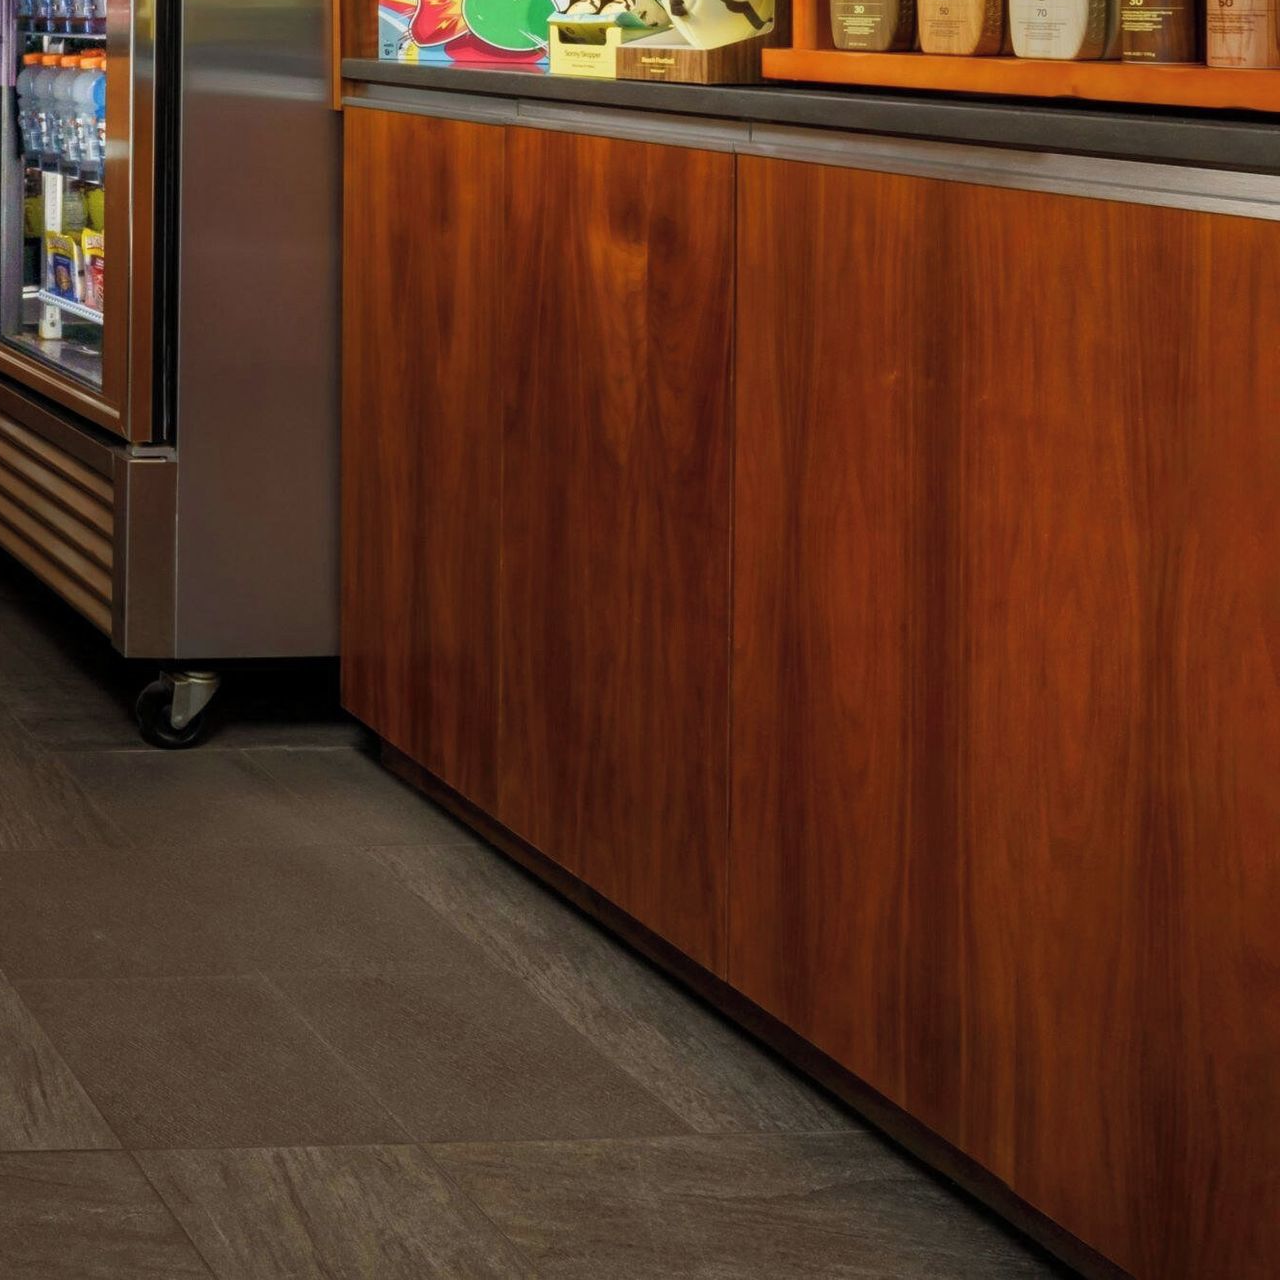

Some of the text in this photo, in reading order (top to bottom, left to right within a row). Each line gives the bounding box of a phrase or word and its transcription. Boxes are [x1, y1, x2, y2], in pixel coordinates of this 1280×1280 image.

[853, 5, 865, 14] 30
[939, 7, 950, 16] 50
[1036, 7, 1048, 17] 70
